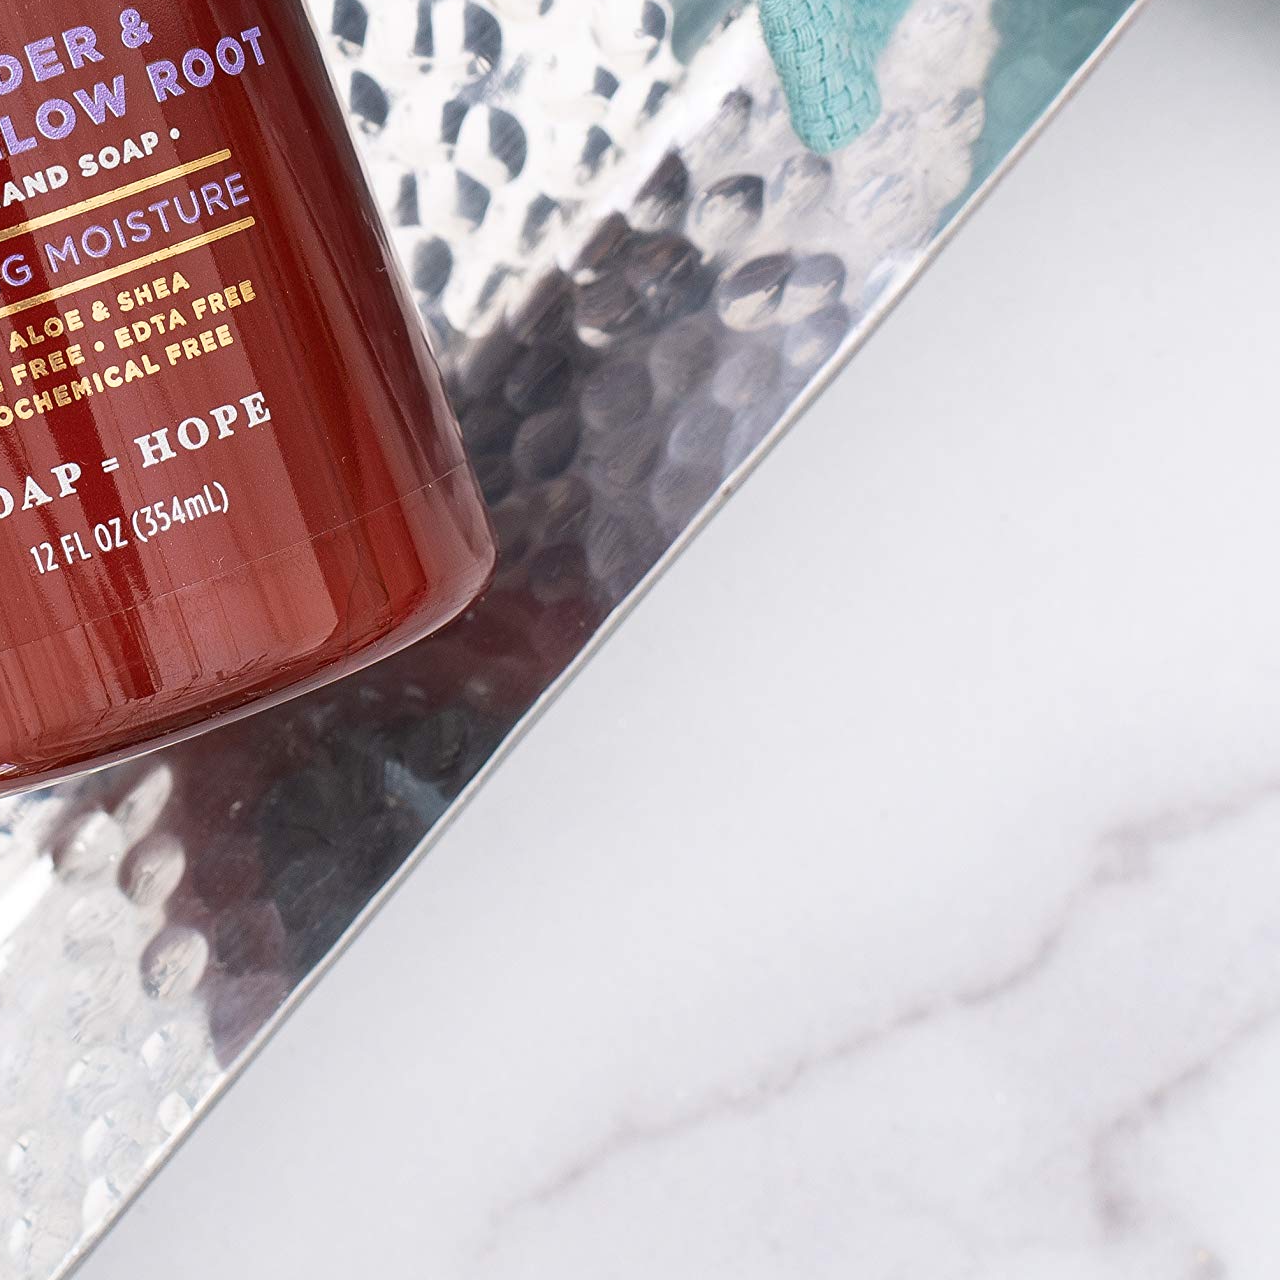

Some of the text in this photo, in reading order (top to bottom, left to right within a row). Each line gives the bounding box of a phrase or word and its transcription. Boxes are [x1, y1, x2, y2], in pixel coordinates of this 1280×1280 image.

[119, 8, 154, 48] &
[150, 26, 266, 102] ROOT
[79, 131, 161, 177] SOAP
[44, 173, 251, 273] MOISTURE
[8, 309, 83, 352] ALOE
[92, 302, 111, 321] &
[118, 271, 191, 311] SHEA
[12, 342, 86, 385] FREE
[115, 309, 187, 349] EDTA
[192, 280, 256, 317] FREE
[168, 324, 234, 365] FREE
[101, 456, 120, 474] =
[133, 391, 271, 469] HOPE
[31, 480, 229, 574] 12 FL OZ (354mL)
